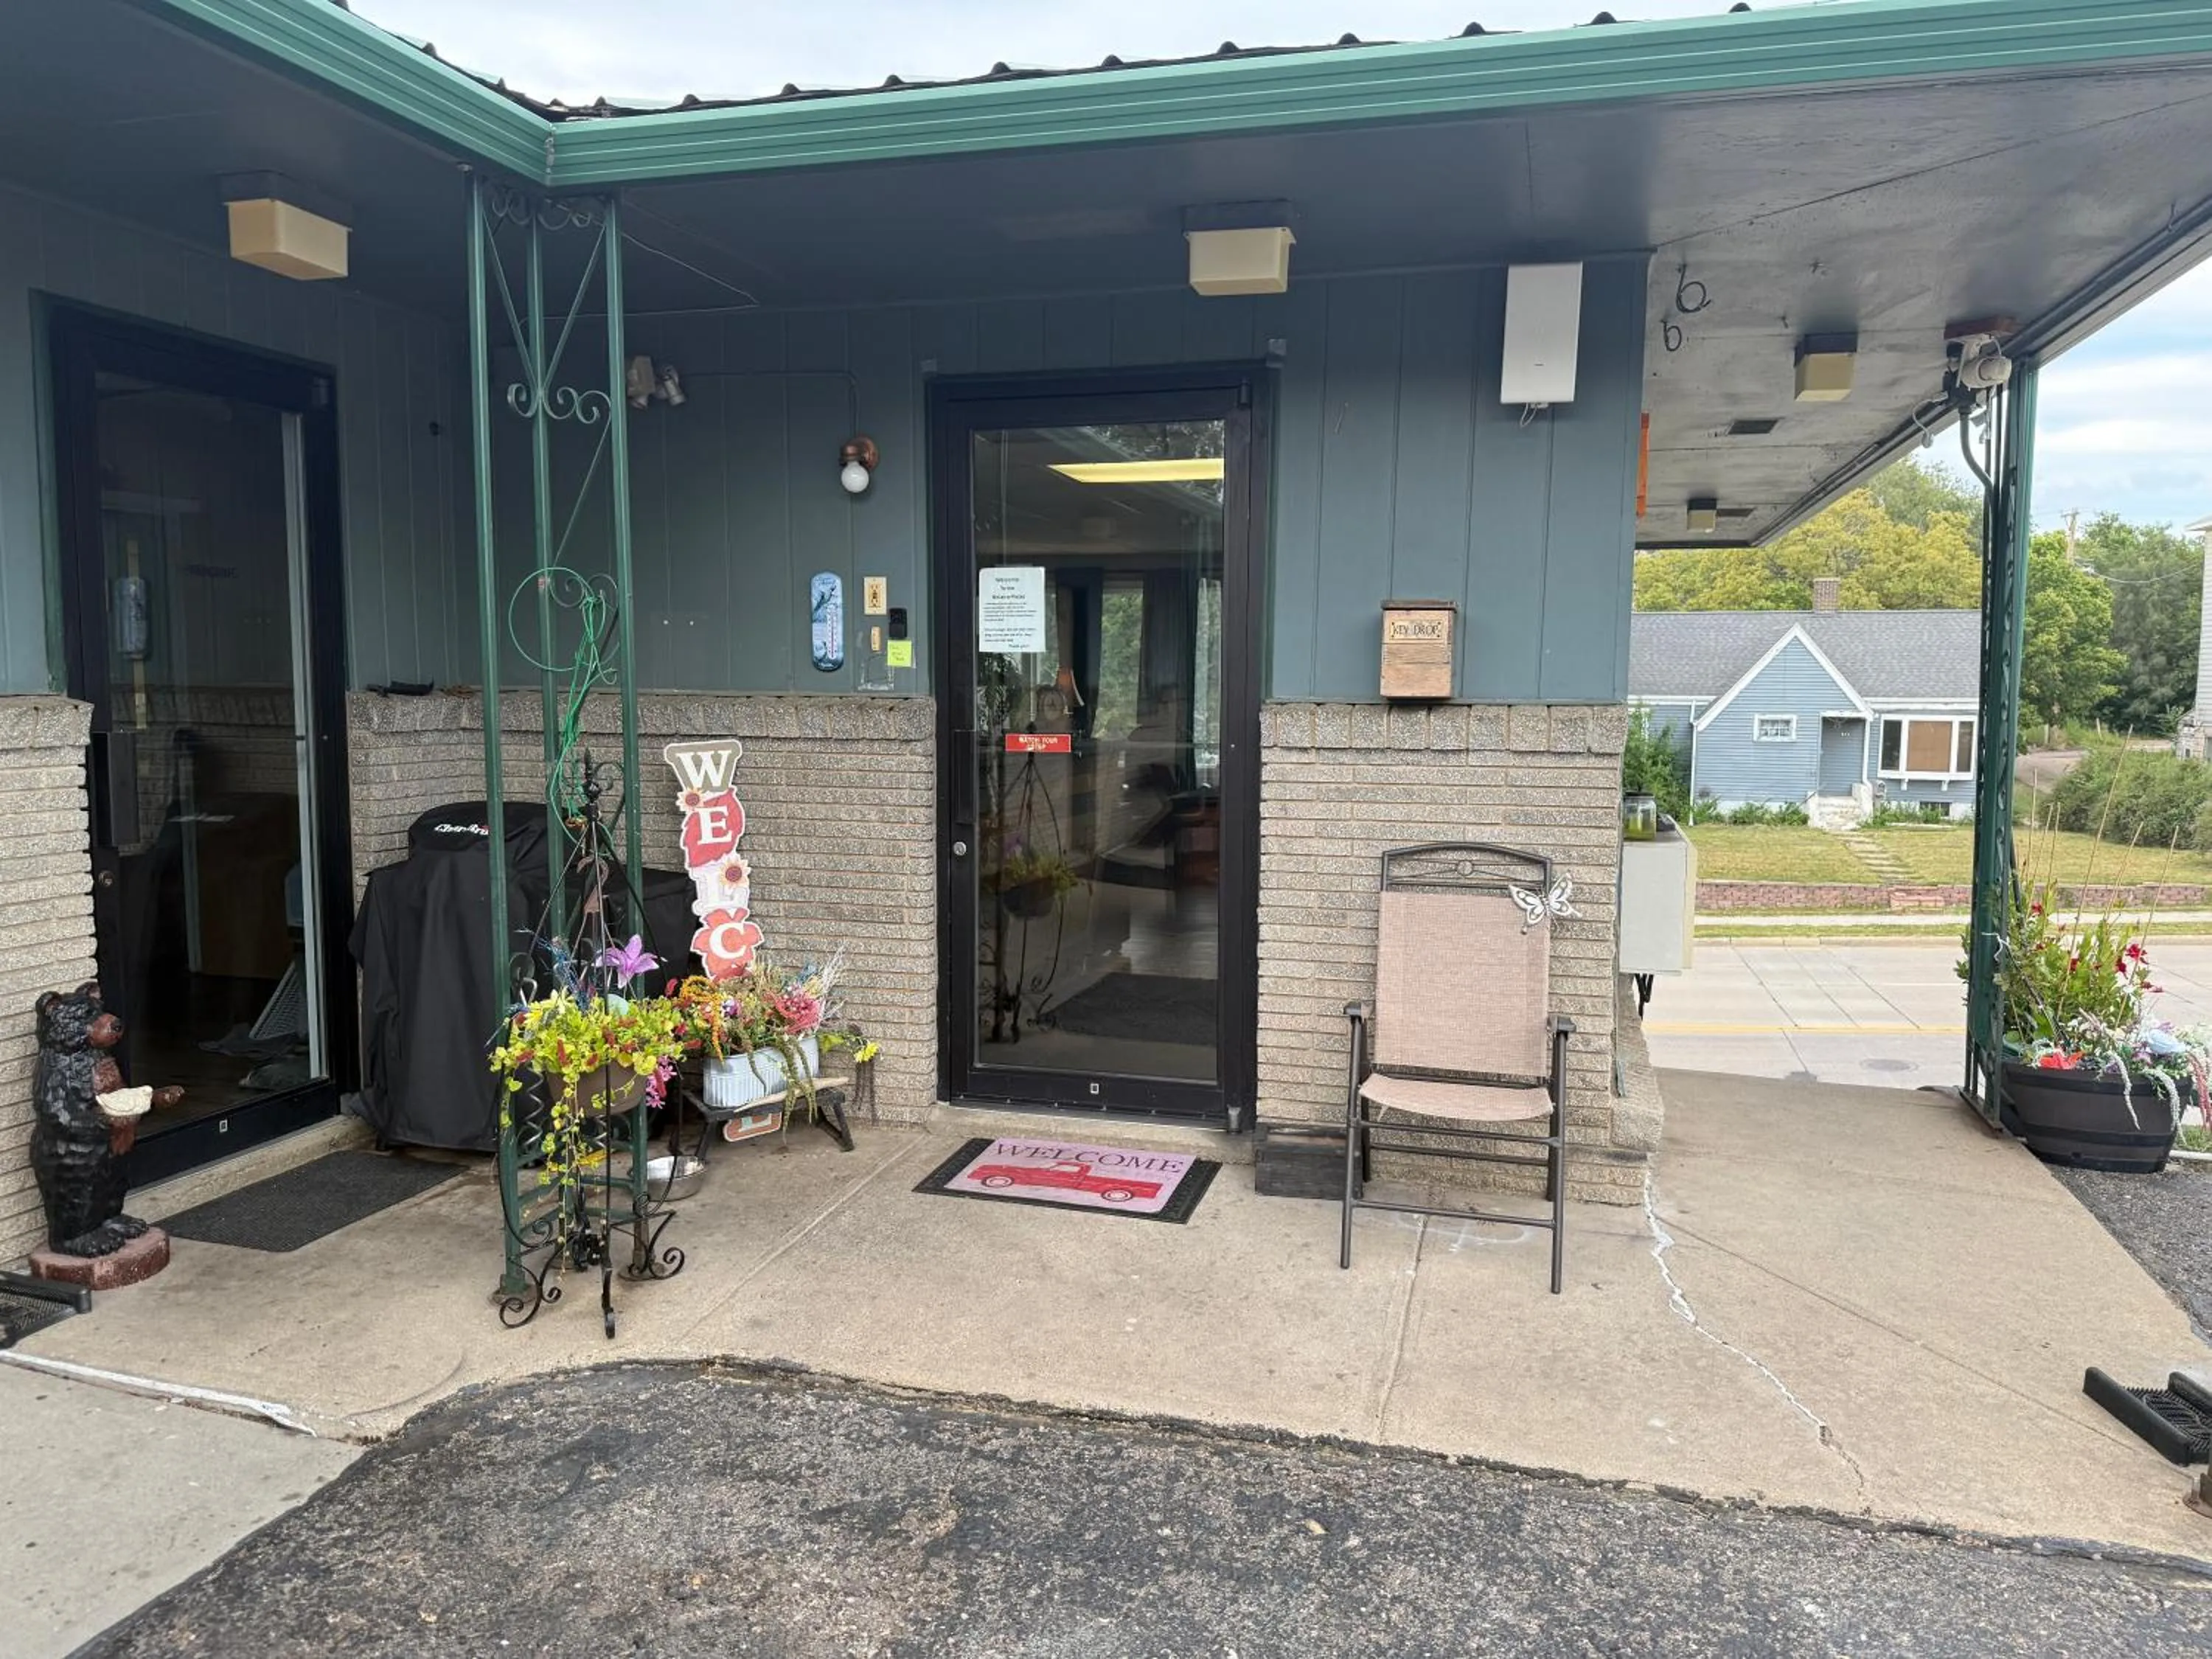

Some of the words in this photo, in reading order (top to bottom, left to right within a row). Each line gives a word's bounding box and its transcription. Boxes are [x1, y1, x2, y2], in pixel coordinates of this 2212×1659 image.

[1393, 625, 1409, 635] KEY
[1413, 625, 1439, 635] DROP
[675, 749, 747, 959] WELC
[995, 1143, 1184, 1173] WELCOME
